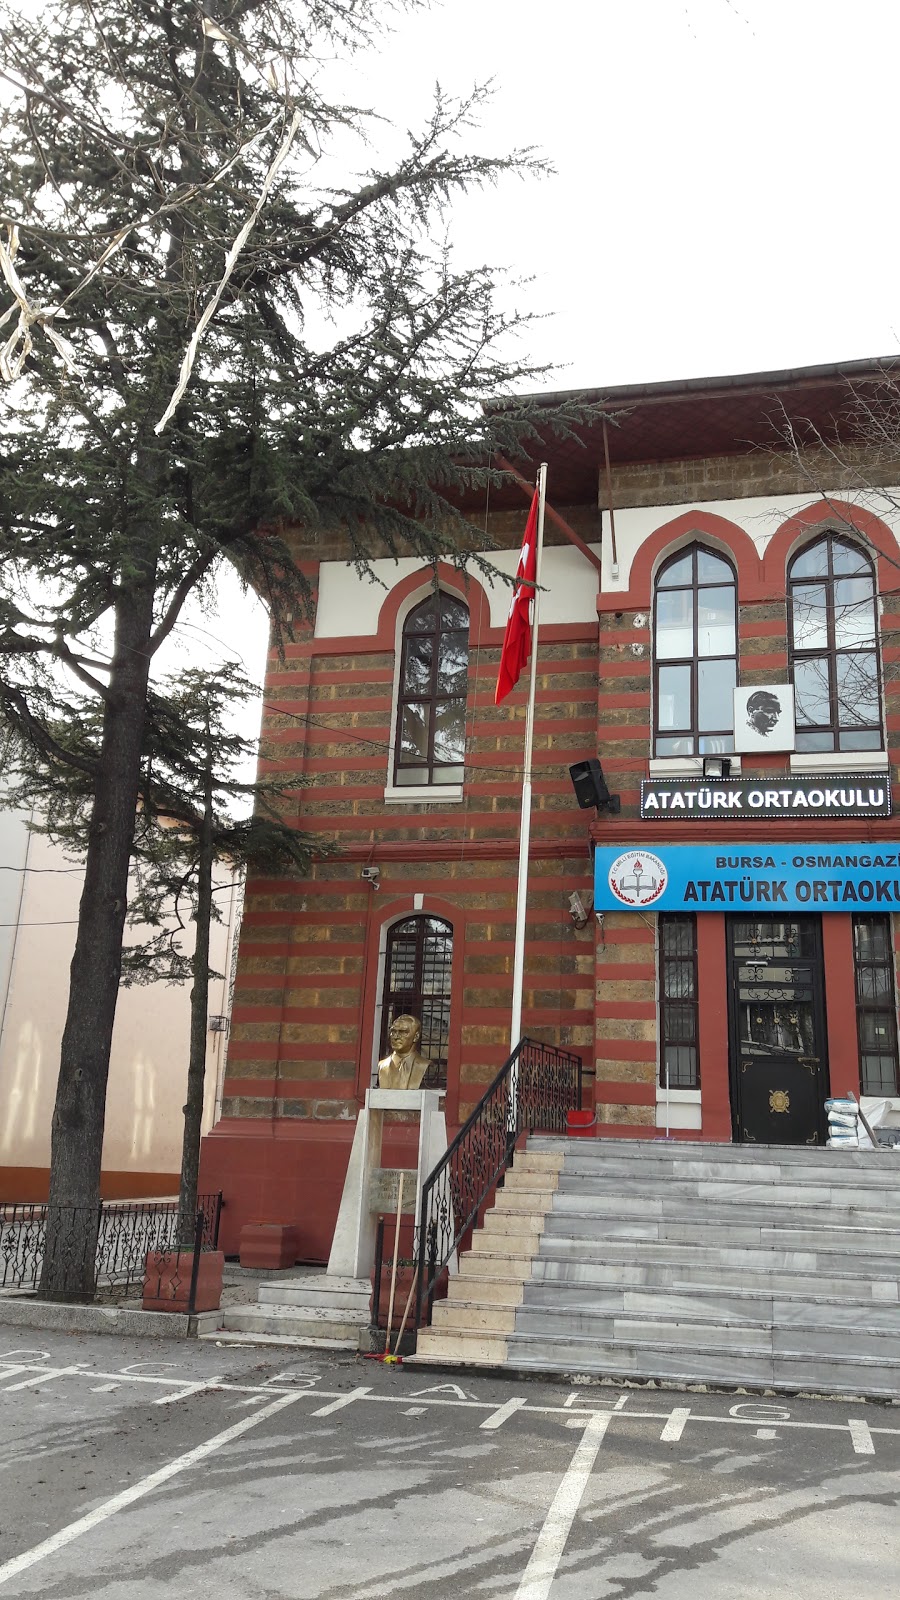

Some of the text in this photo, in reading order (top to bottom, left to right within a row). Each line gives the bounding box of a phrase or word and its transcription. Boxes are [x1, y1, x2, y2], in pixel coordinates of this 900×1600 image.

[644, 789, 884, 809] ATATÜRK ORTAOKULU
[716, 856, 776, 869] BURSA
[683, 876, 788, 902] ATATÜRK
[258, 1372, 322, 1389] B
[409, 1383, 472, 1400] A
[728, 1403, 792, 1420] G
